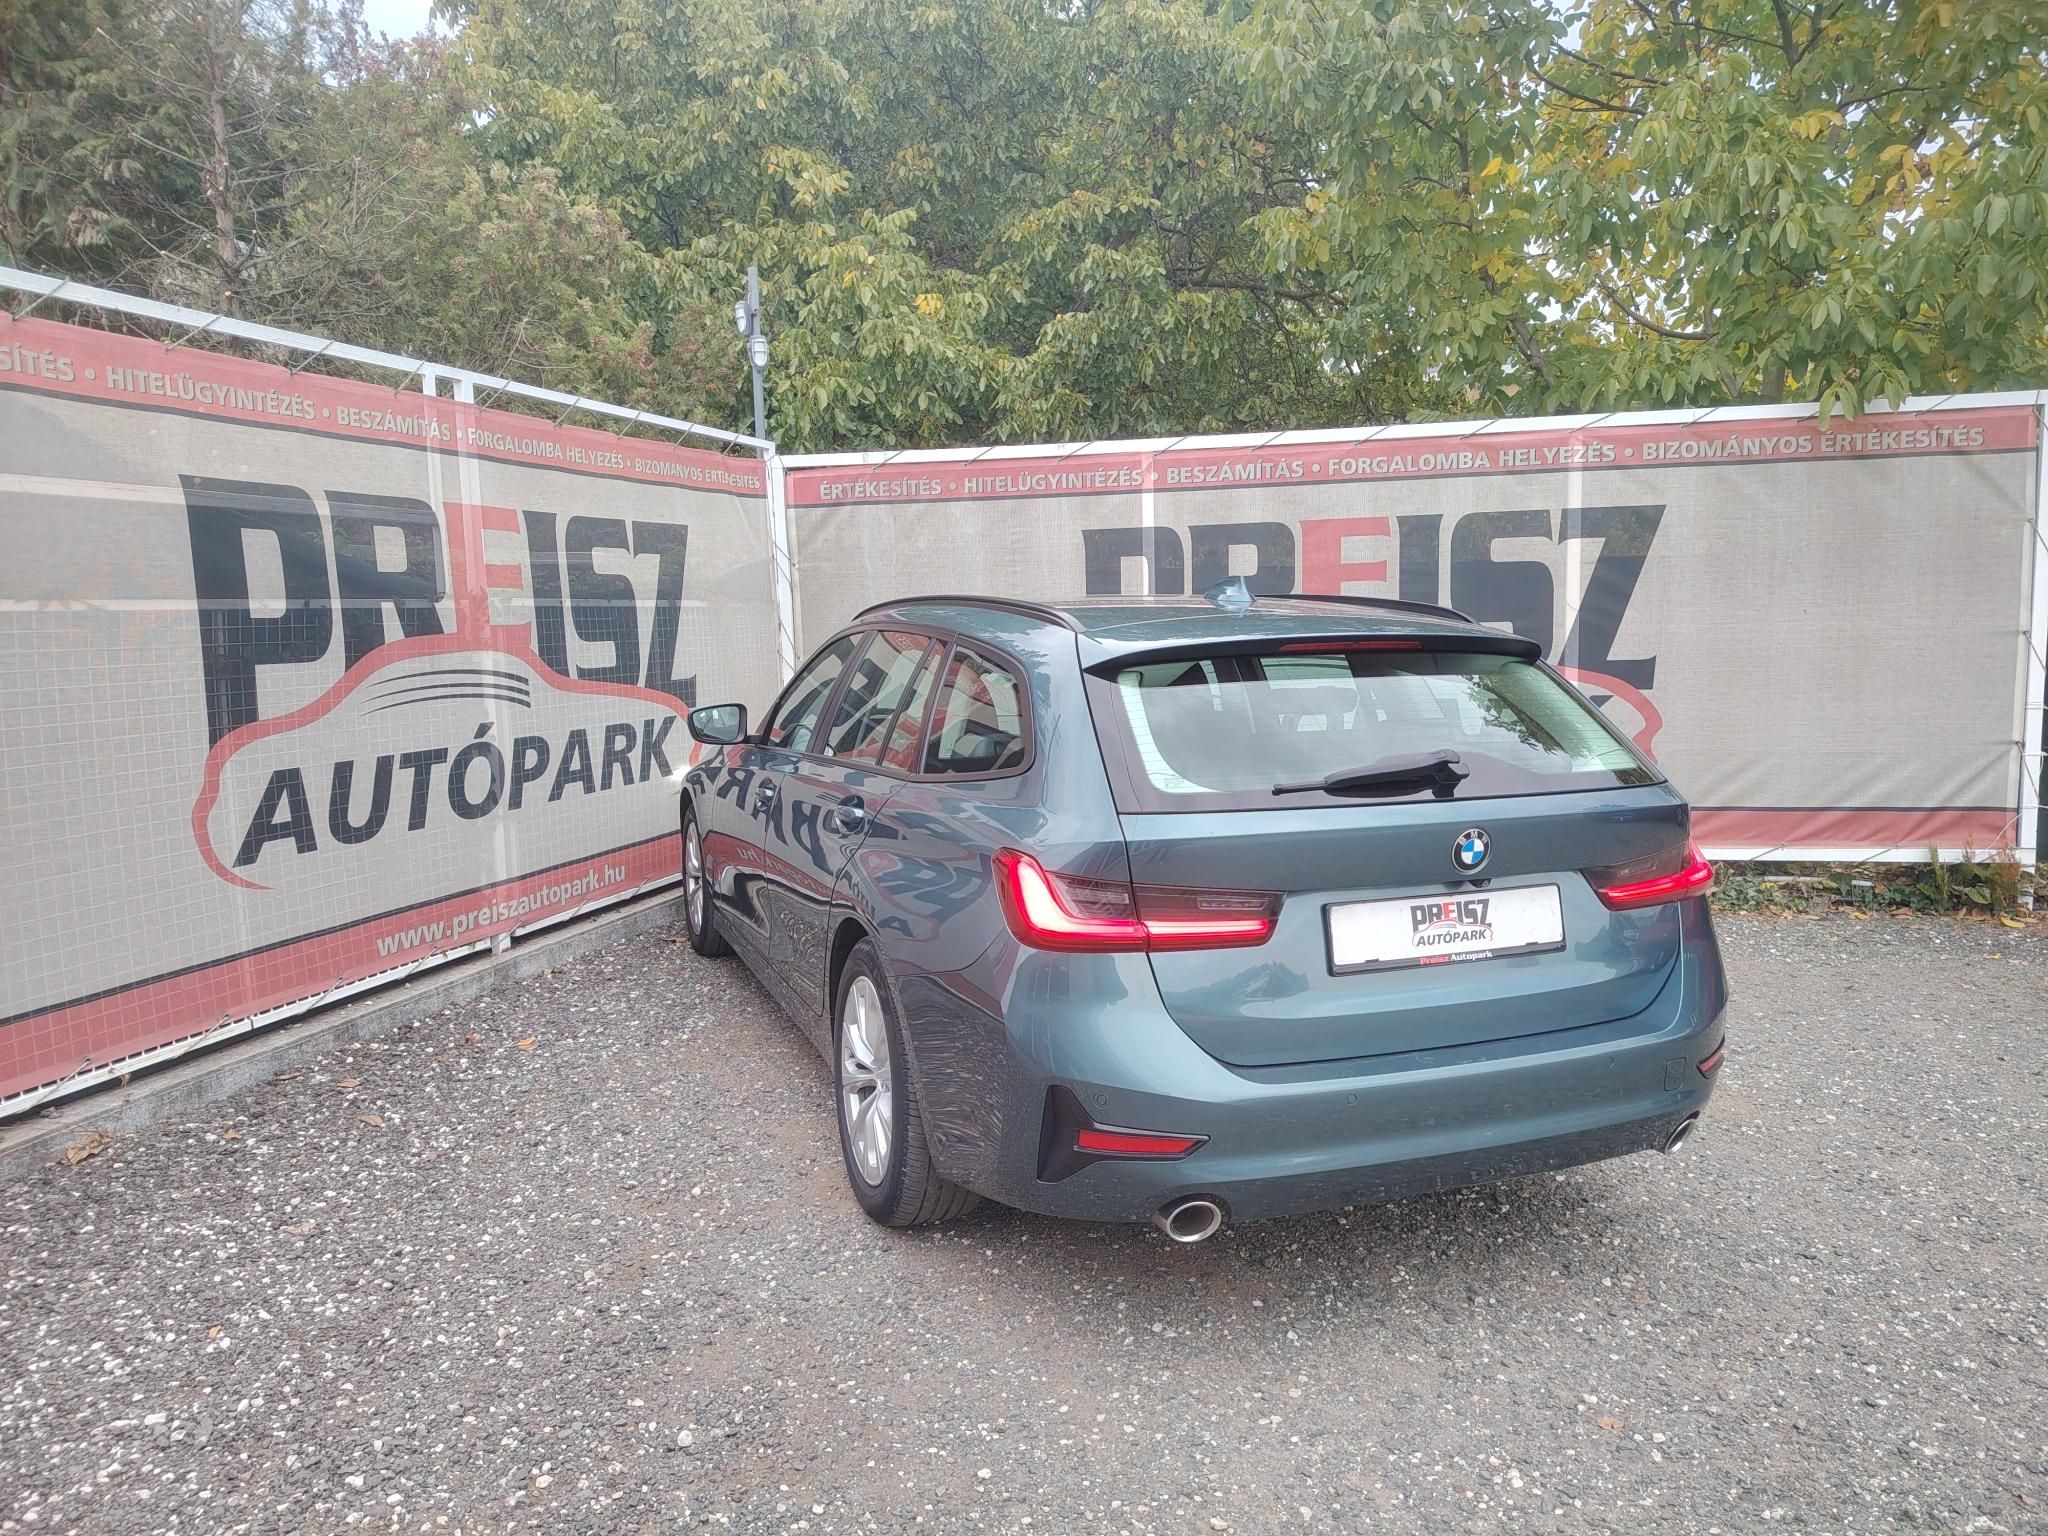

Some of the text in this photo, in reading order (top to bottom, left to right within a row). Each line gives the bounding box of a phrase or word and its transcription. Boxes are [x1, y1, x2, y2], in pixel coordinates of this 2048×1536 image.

[106, 365, 316, 421] HITELÜGYINTÉZÉS
[336, 406, 451, 441] BESZÁMÍTÁS
[468, 427, 563, 460] FORGALOMBA
[566, 447, 624, 470] HELYEZÉS
[819, 424, 1985, 500] ÉRTÉKESÍTÉS HITELÜGYINTÉZÉS BESZÁMÍTÁS FORGALOMBA HELYEZÉS BIZOMÁNYOS ÉRTÉKESÍTÉS
[178, 473, 697, 750] PREISZ
[231, 714, 677, 868] AUTÓPARK
[1458, 830, 1488, 846] BMW
[376, 864, 626, 957] www.preiszautopark.hu
[1410, 898, 1492, 933] PREISZ
[1416, 928, 1486, 947] AUTÓPARK
[1419, 950, 1493, 966] Preisz Autopark
